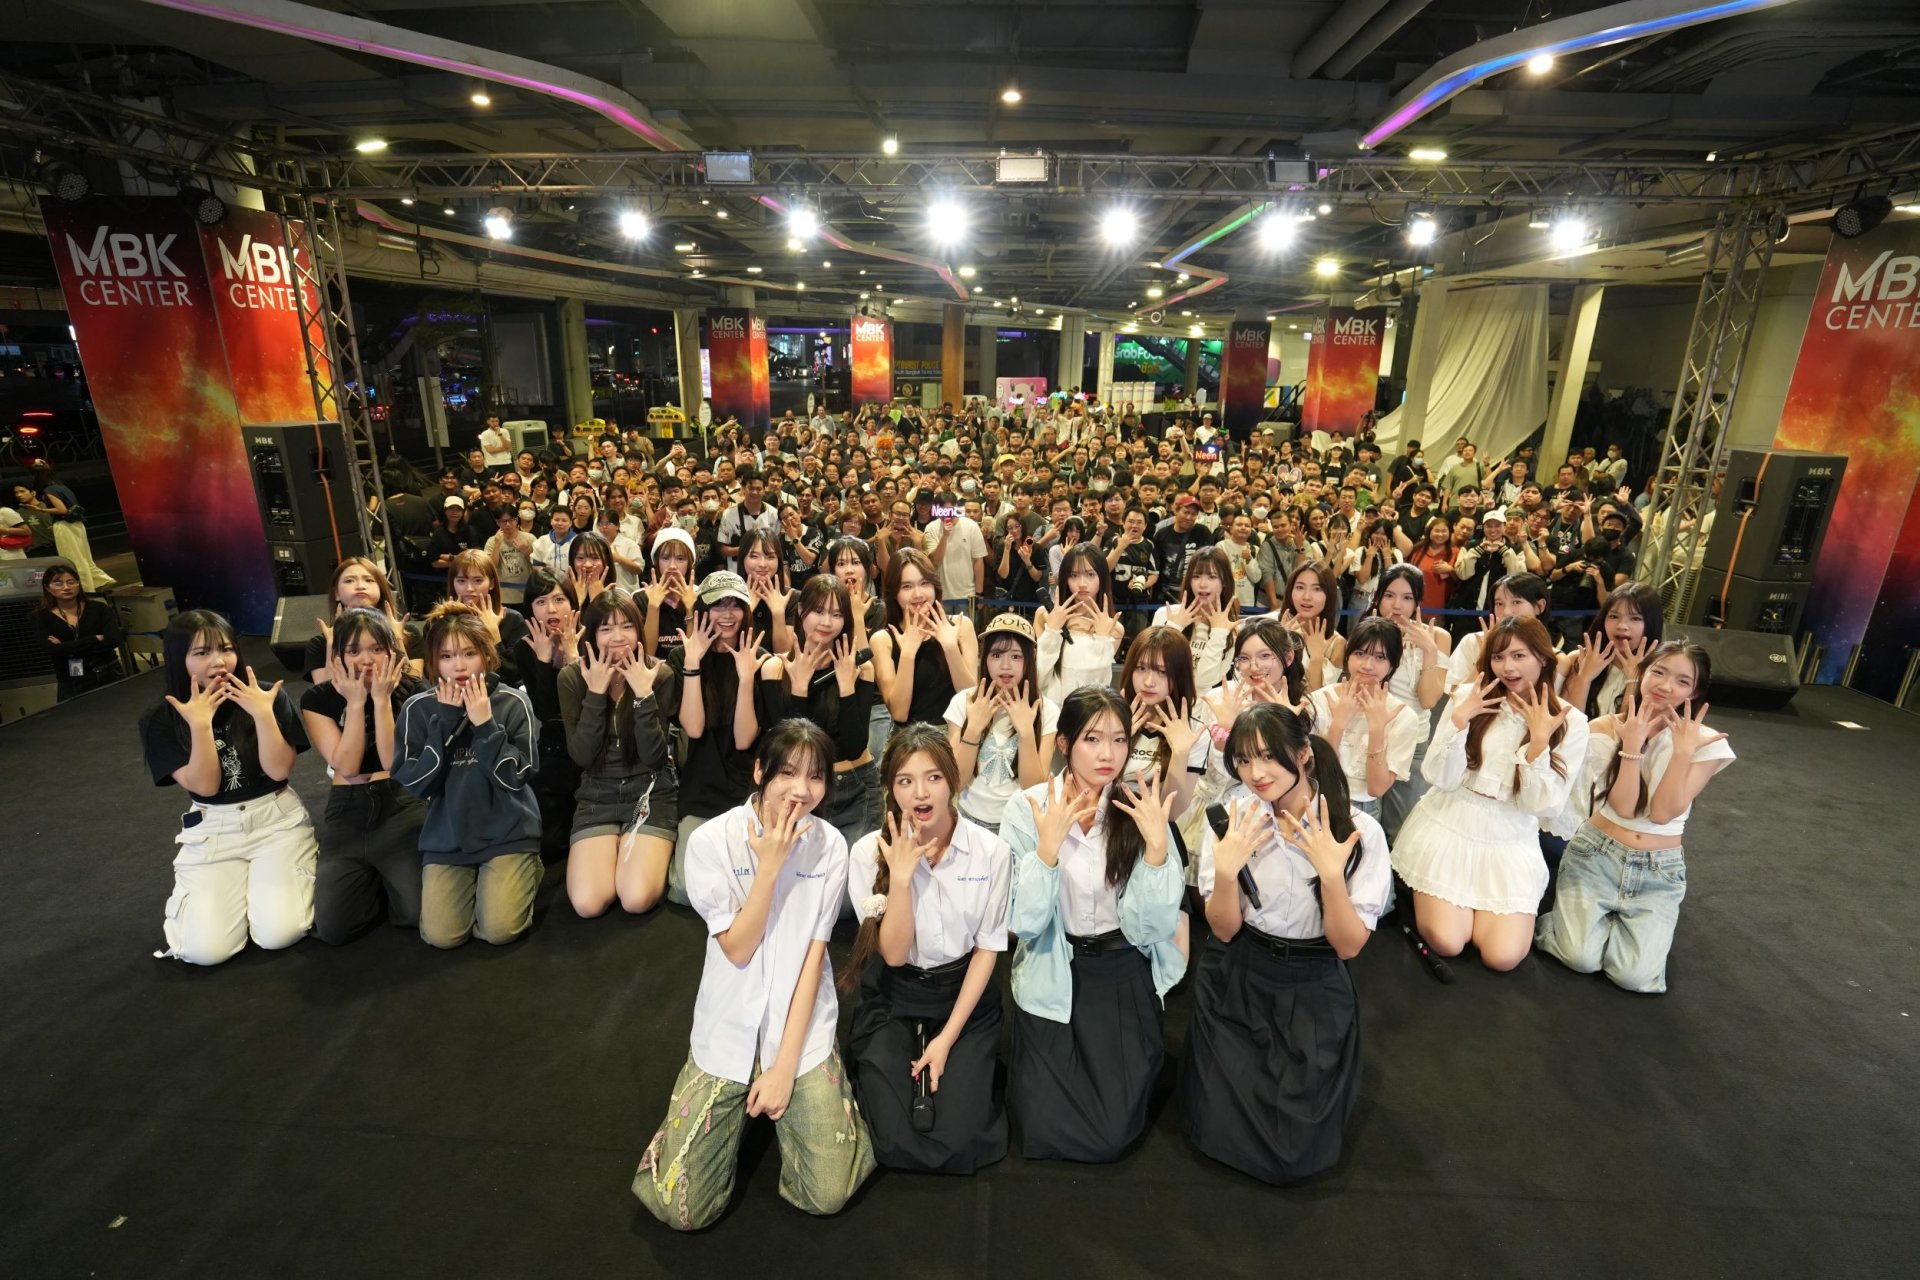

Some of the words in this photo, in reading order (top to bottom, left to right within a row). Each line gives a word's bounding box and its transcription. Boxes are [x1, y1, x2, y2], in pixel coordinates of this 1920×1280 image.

[66, 226, 186, 277] MBK
[217, 234, 305, 286] MBK
[1831, 250, 1920, 303] MB
[80, 280, 193, 306] CENTER
[229, 282, 312, 313] CENTER
[711, 316, 744, 331] MBK
[751, 316, 766, 331] MBK
[856, 321, 885, 335] MBK
[1334, 316, 1379, 336] MBK
[712, 331, 745, 339] CENTER
[856, 334, 885, 342] CENTER
[1236, 328, 1266, 341] MBK
[1333, 335, 1377, 345] CENTER
[1234, 341, 1265, 349] CENTER
[254, 437, 274, 445] MBK
[1808, 467, 1832, 476] MBK
